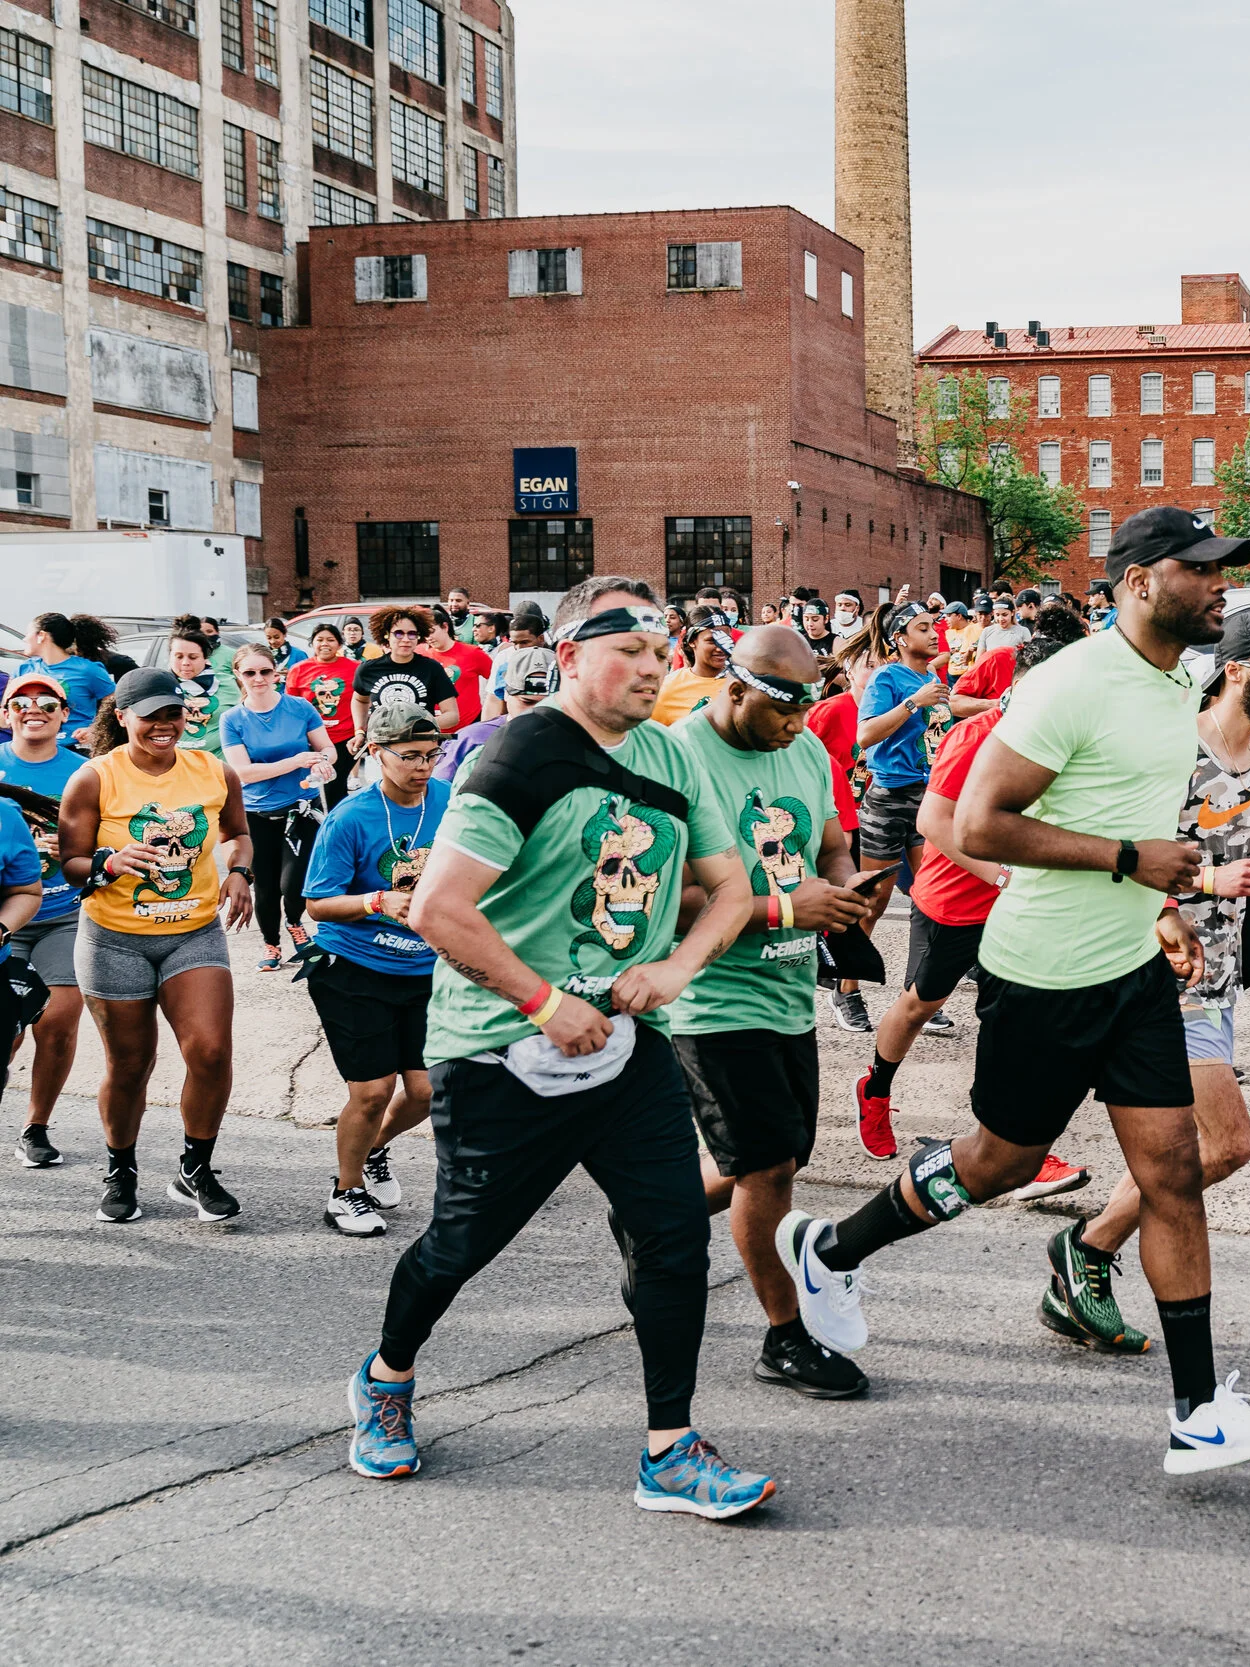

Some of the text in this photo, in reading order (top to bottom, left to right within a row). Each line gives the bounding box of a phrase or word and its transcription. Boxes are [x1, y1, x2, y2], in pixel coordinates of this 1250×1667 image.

[520, 477, 568, 492] EGAN
[520, 497, 569, 509] SIGN
[388, 673, 411, 682] LIVES
[134, 899, 201, 916] NEMESIS
[437, 947, 489, 983] Despite
[778, 955, 811, 970] DTLR
